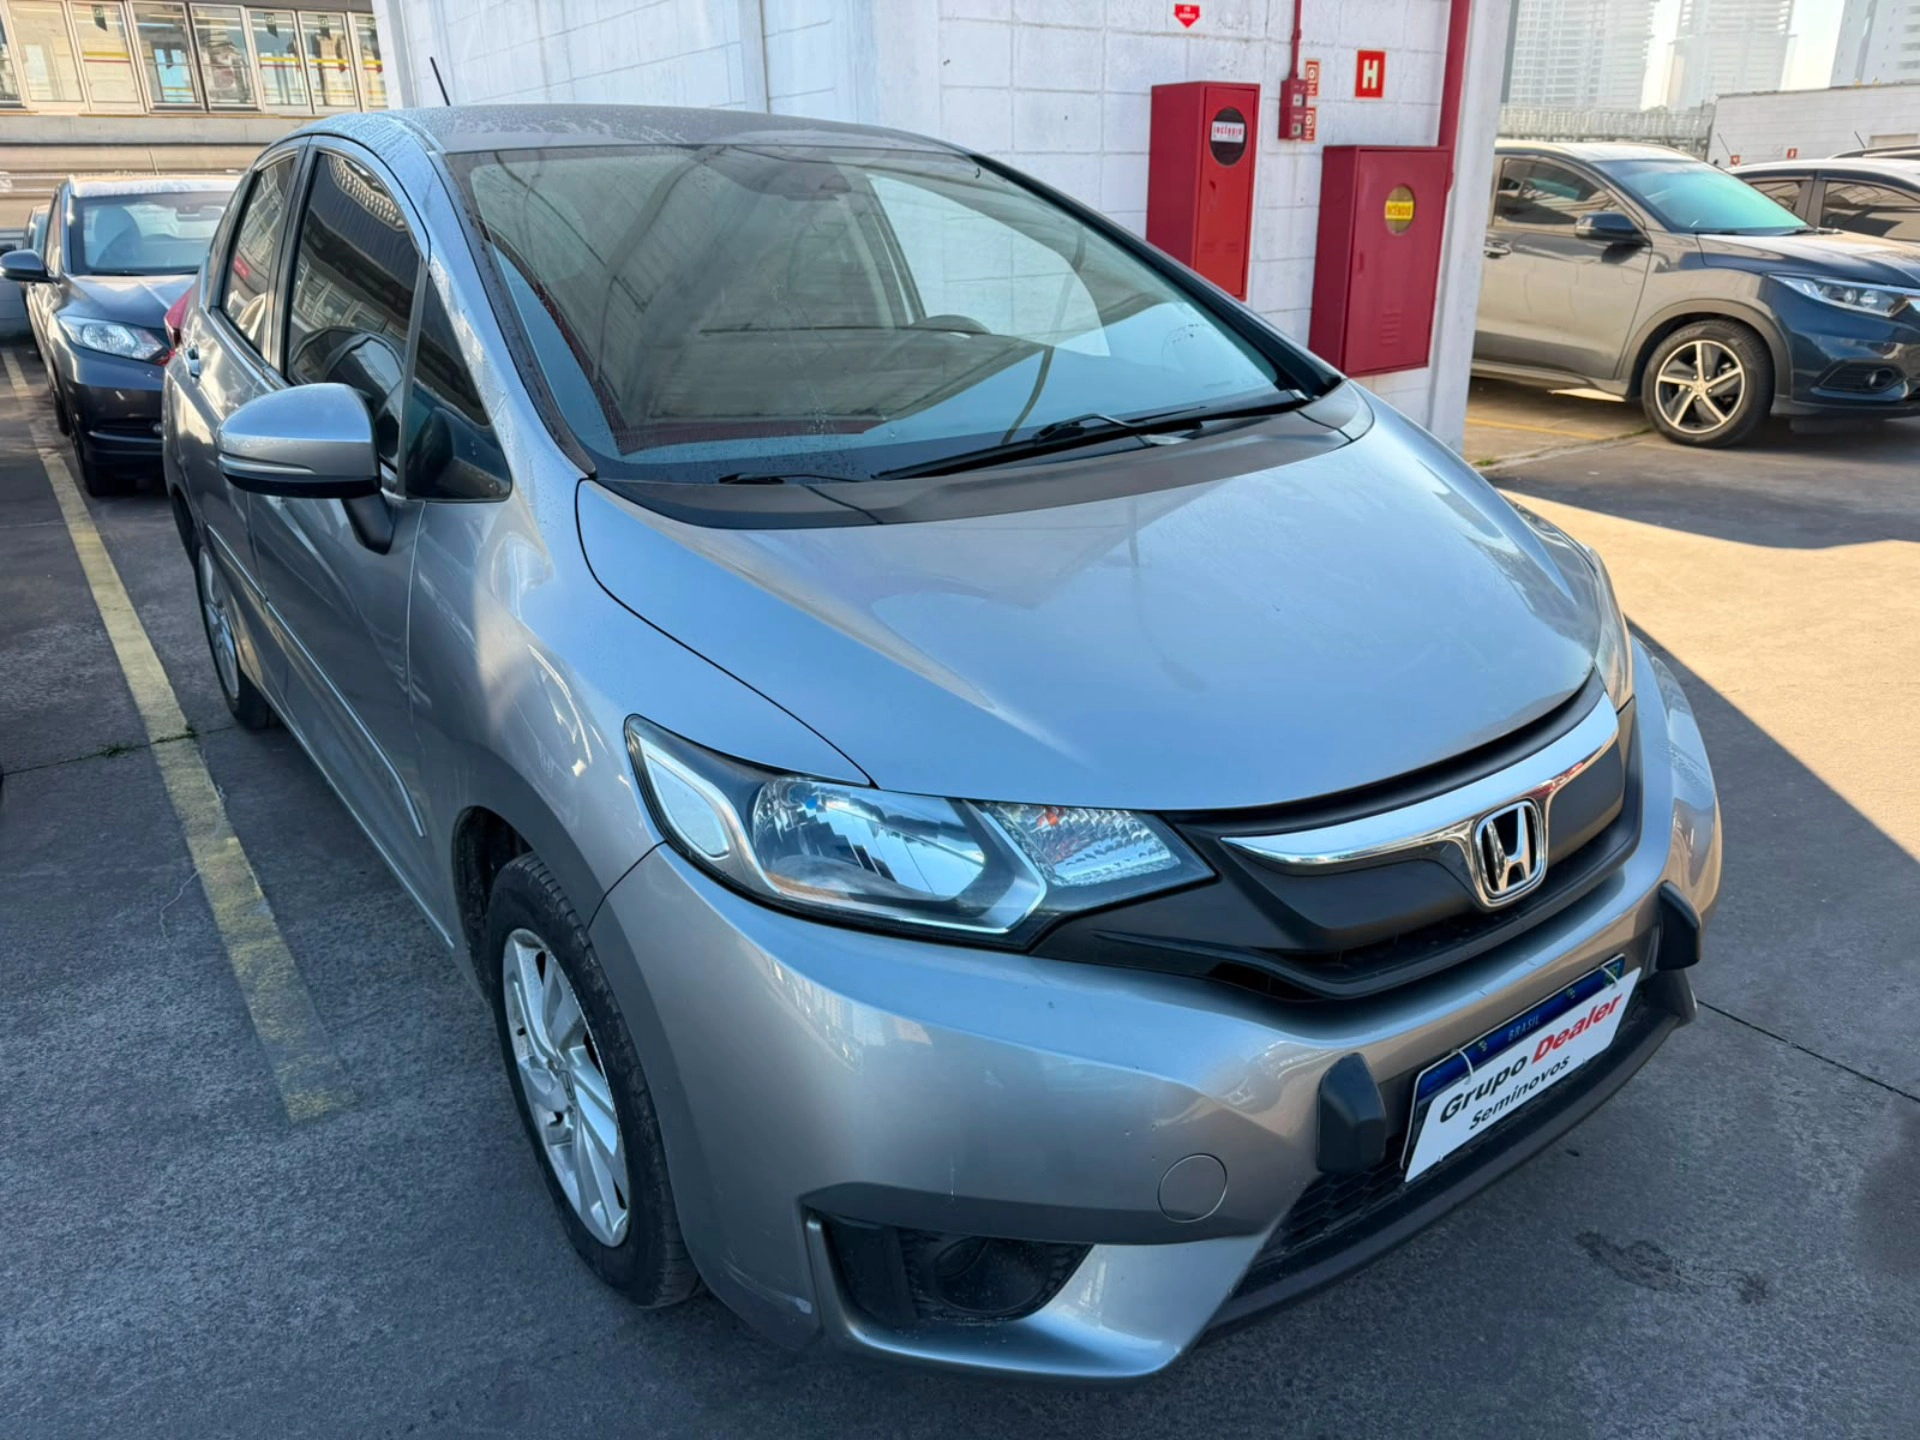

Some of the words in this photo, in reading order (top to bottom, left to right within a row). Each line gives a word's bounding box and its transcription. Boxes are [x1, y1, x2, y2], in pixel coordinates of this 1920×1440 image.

[1362, 60, 1379, 89] H
[1440, 1056, 1528, 1123] Grupo
[1531, 993, 1623, 1064] Dealer
[1469, 1056, 1570, 1131] Seminovos
